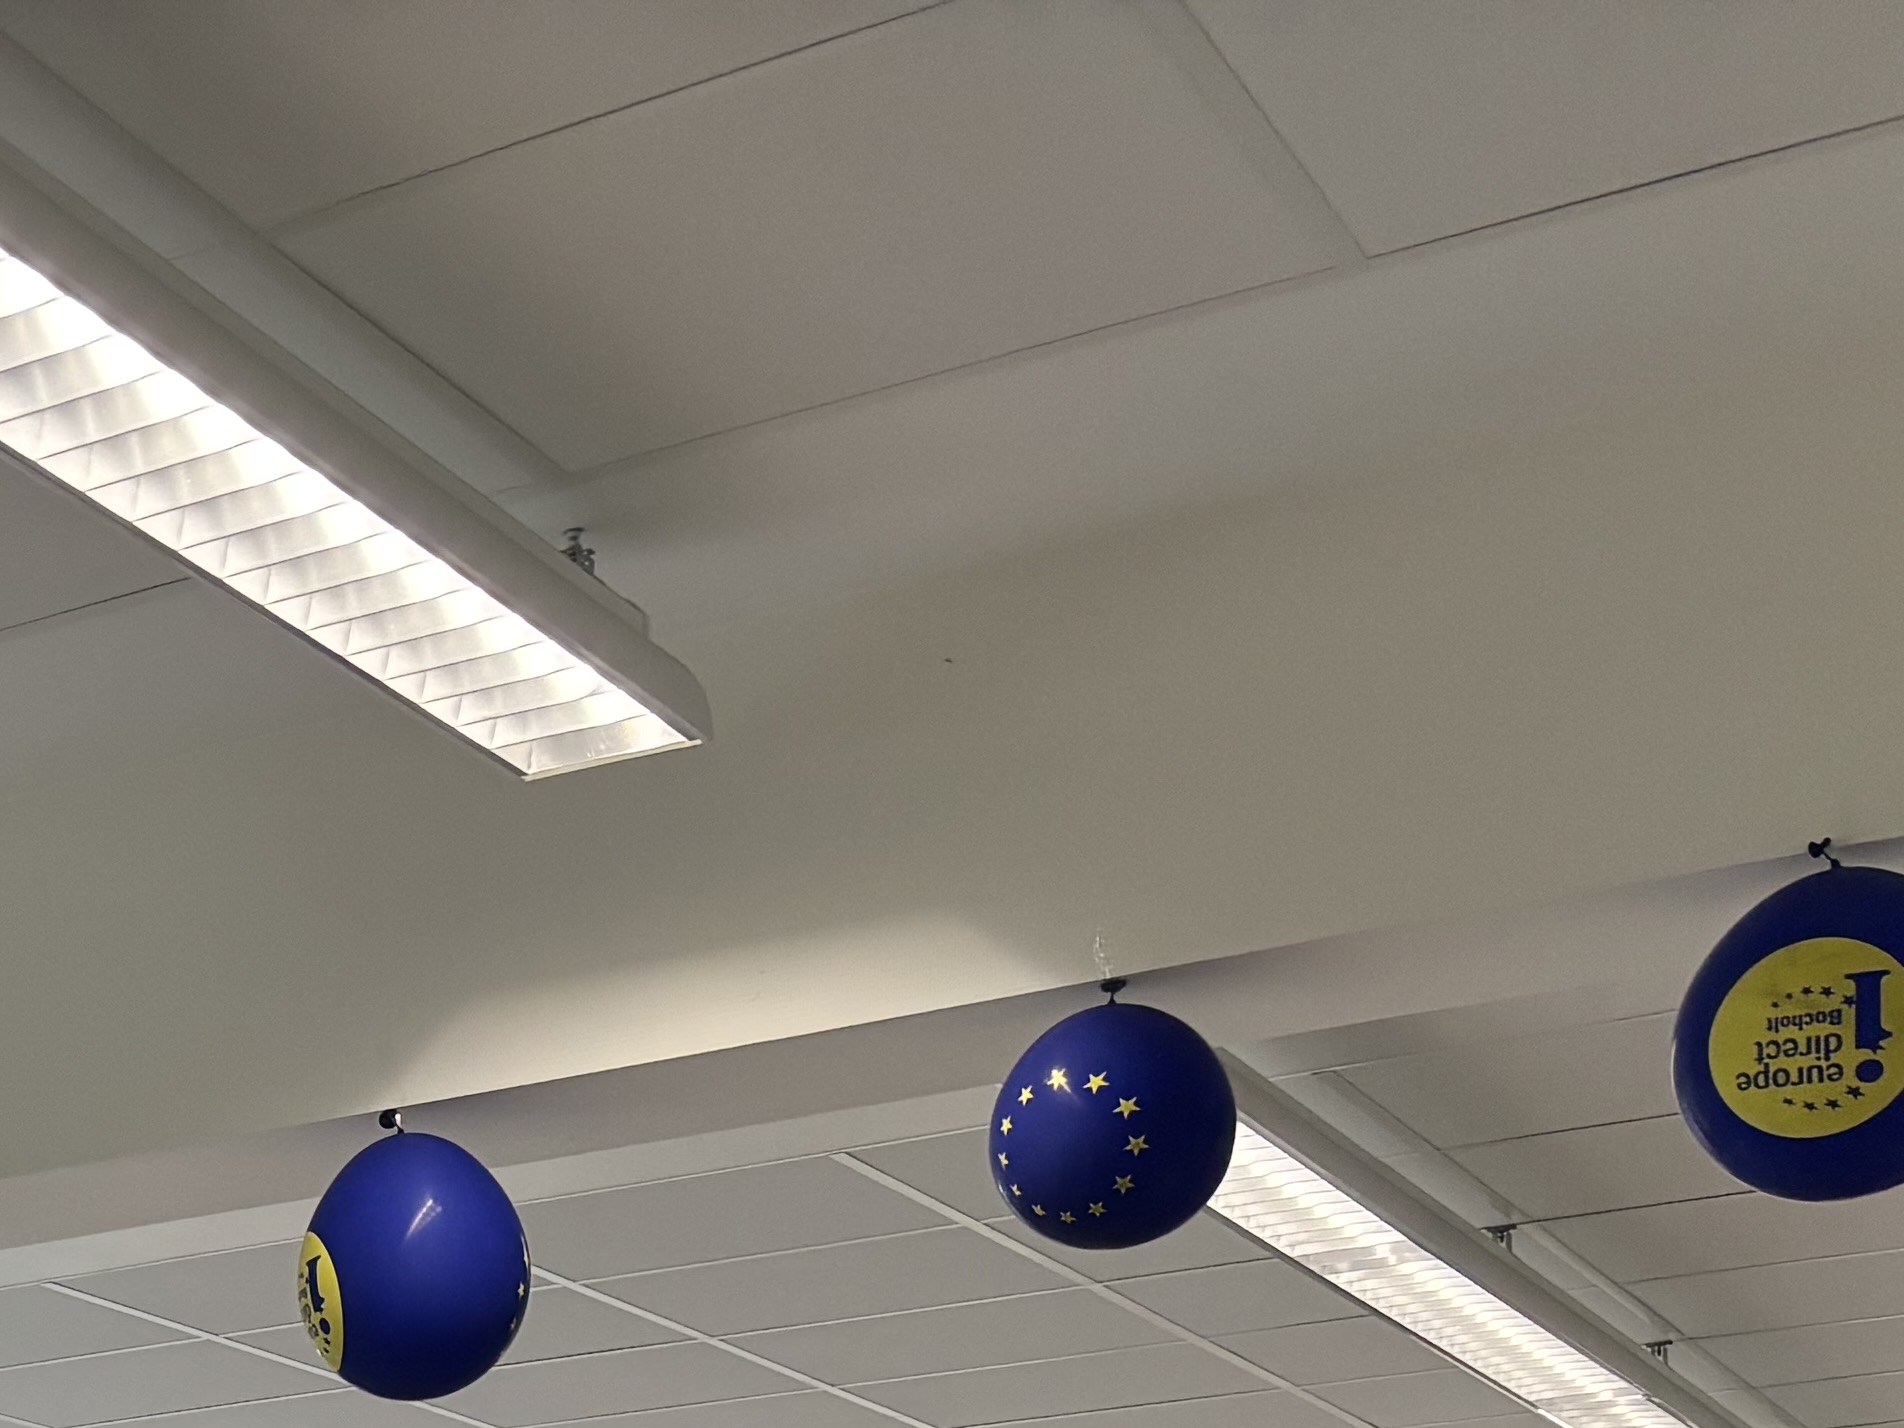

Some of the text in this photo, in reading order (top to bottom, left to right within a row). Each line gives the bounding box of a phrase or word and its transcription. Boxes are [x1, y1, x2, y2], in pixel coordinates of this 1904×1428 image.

[1766, 1008, 1843, 1033] Bocholt
[1753, 1032, 1843, 1065] direct
[1735, 1062, 1844, 1091] europe
